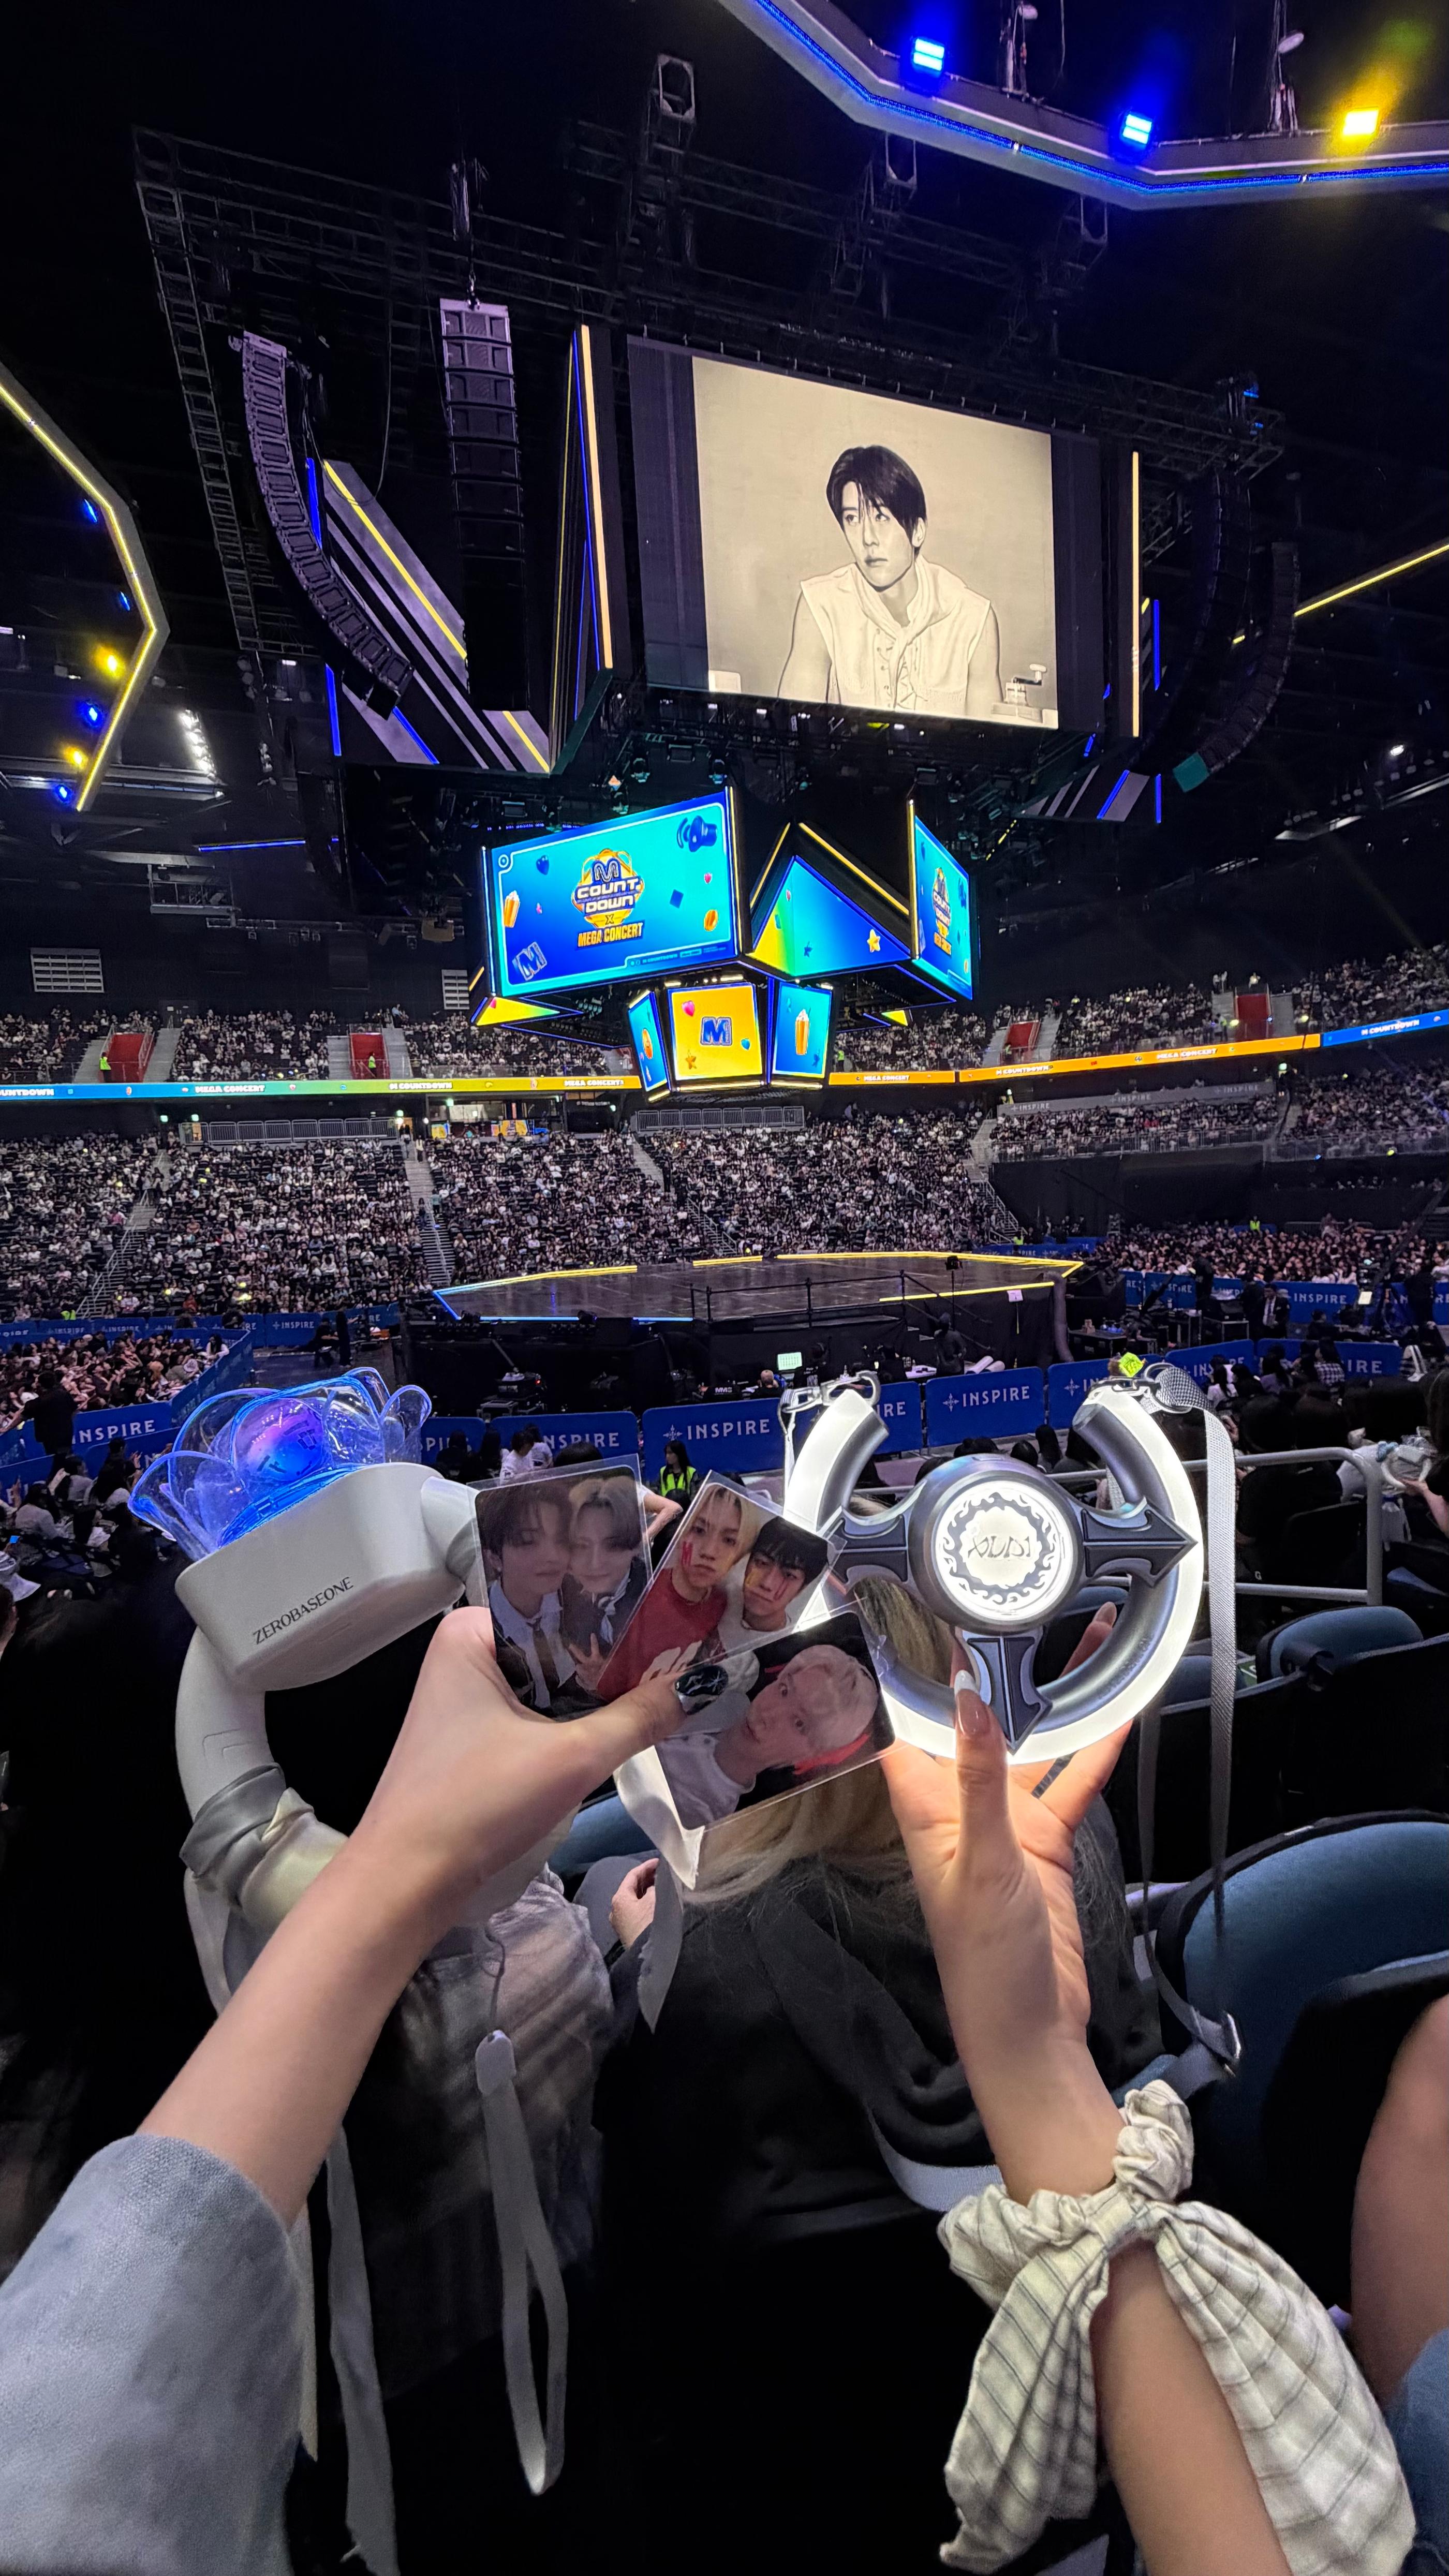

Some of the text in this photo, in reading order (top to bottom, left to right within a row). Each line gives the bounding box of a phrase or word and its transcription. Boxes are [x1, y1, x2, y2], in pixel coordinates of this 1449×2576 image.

[586, 895, 633, 913] DOWN
[578, 923, 643, 948] MEGA CONCERT
[1369, 1019, 1420, 1034] COUNTDOWN
[1180, 1048, 1217, 1058] CONCERT
[1003, 1065, 1049, 1075] COUNTDOWN
[223, 1085, 265, 1093] CONCERT
[399, 1082, 452, 1090] COUNTDOWN
[0, 1088, 54, 1097] UNTDOWN
[1118, 1094, 1151, 1102] INSPIRE
[1019, 1103, 1049, 1112] INSPIRE
[1294, 1293, 1347, 1305] INSPIRE
[962, 1385, 1030, 1408] INSPIRE
[687, 1418, 770, 1441] INSPIRE
[252, 1576, 354, 1645] ZEROBASEONE
